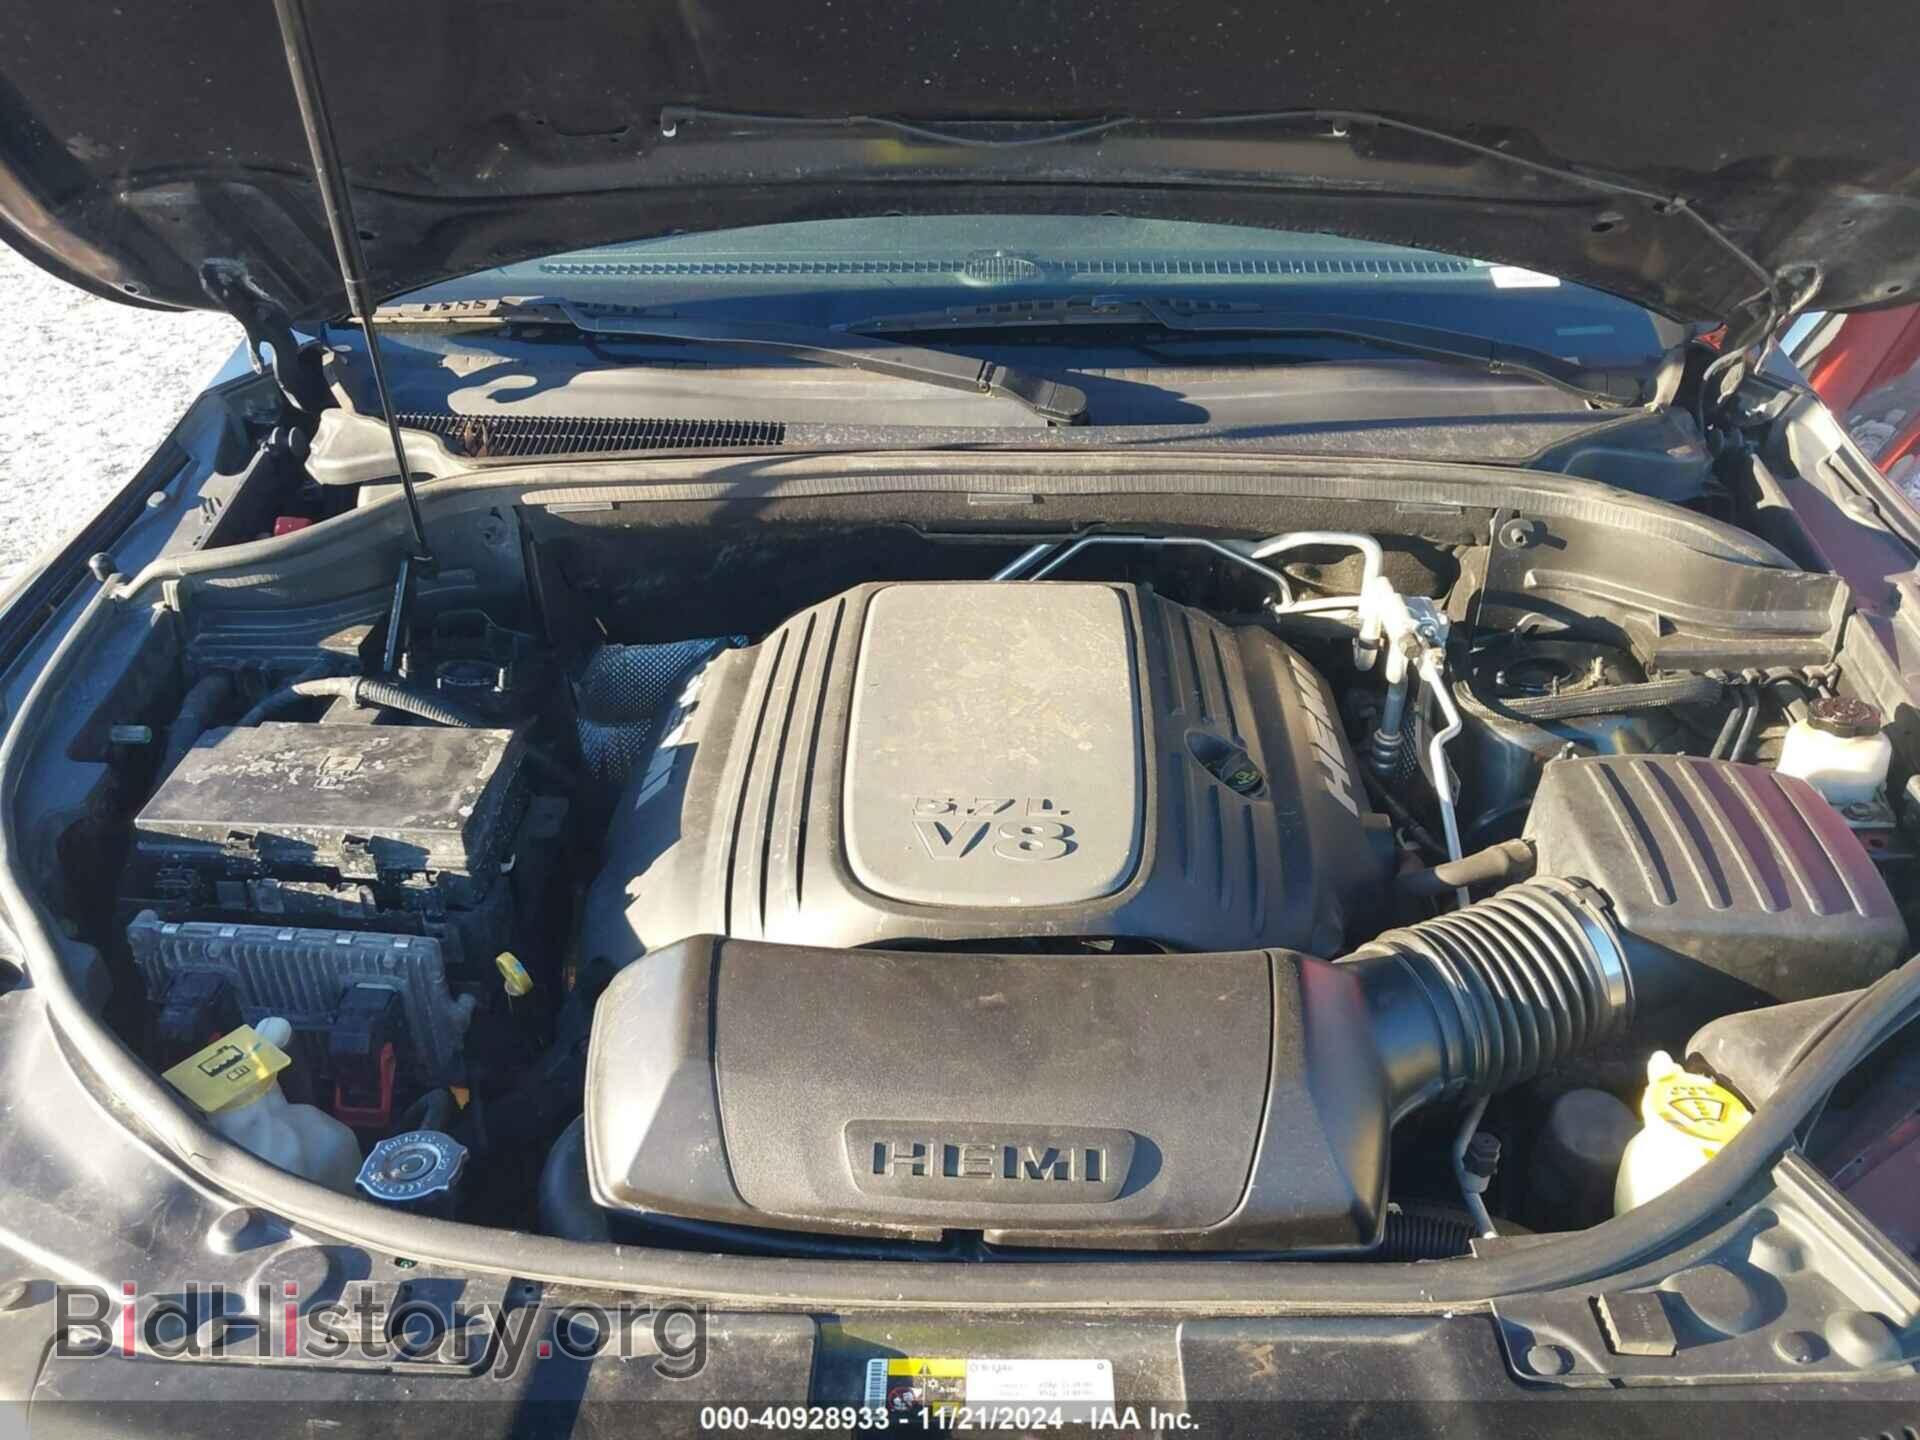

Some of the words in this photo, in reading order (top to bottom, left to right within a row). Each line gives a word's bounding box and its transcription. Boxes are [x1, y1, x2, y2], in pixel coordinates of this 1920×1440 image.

[1289, 655, 1359, 818] HEMI
[912, 820, 1079, 862] V8
[873, 1142, 1107, 1183] HEMI
